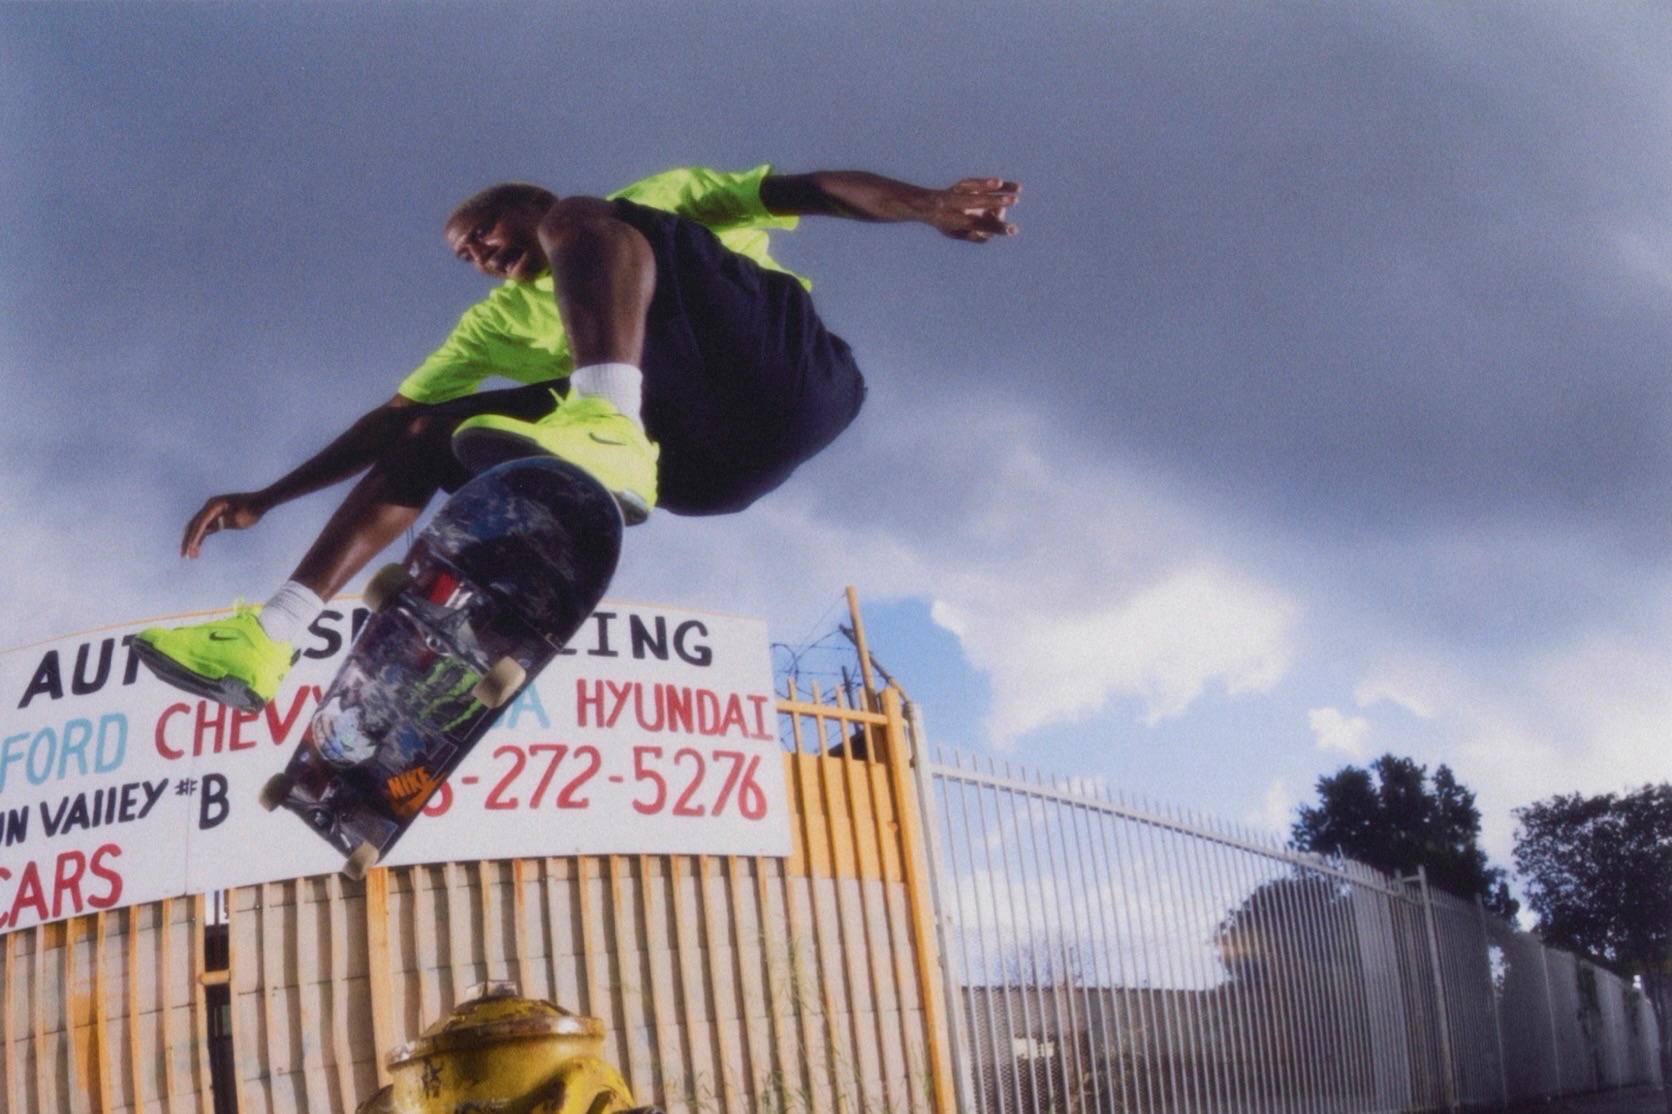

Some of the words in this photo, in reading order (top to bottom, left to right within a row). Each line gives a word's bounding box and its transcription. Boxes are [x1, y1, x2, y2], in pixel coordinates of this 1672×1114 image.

[18, 634, 140, 708] AUT
[559, 611, 712, 667] ING
[0, 712, 128, 793] FORD
[155, 685, 323, 760] CHEV
[576, 678, 773, 741] HYUNDAI
